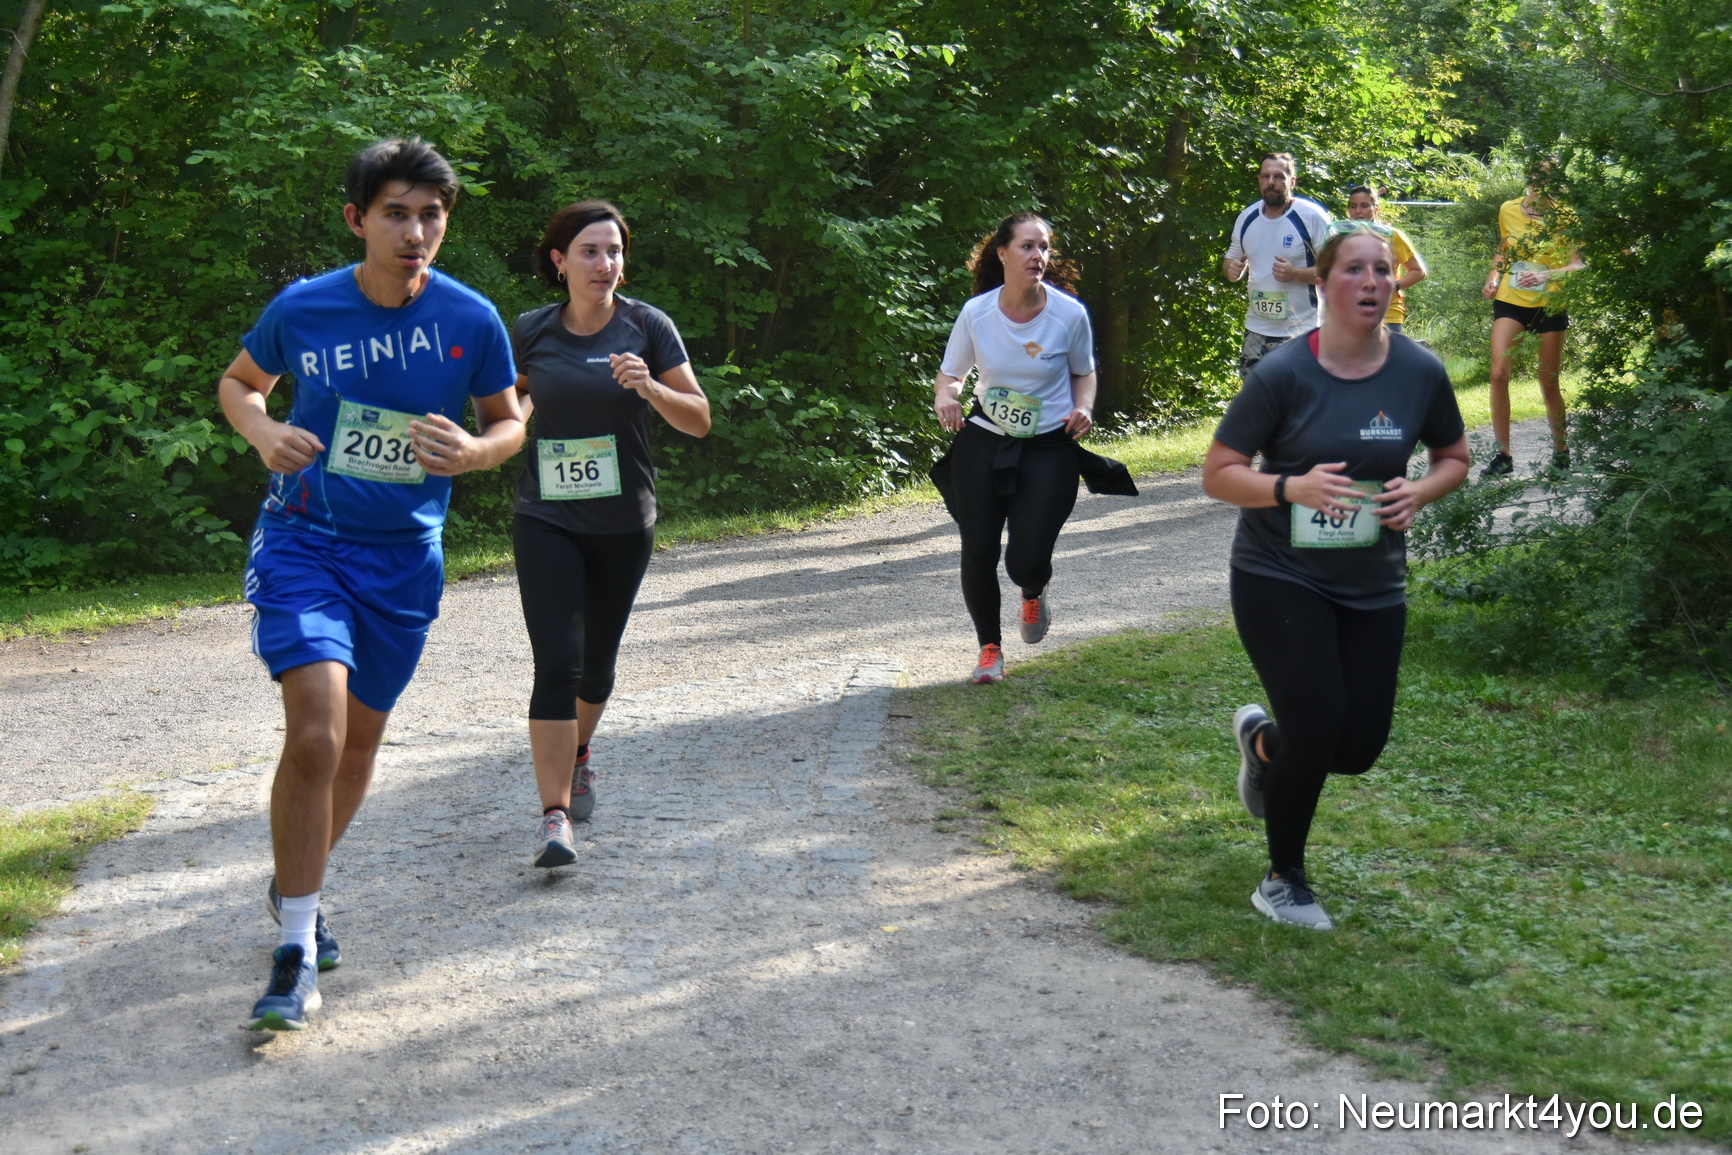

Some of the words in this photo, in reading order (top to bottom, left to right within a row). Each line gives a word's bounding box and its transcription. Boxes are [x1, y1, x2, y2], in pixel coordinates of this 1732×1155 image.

[1255, 300, 1283, 313] 1875
[989, 401, 1033, 427] 1356
[343, 430, 417, 464] 2036
[348, 456, 391, 470] Brachvogel
[555, 460, 600, 483] 156
